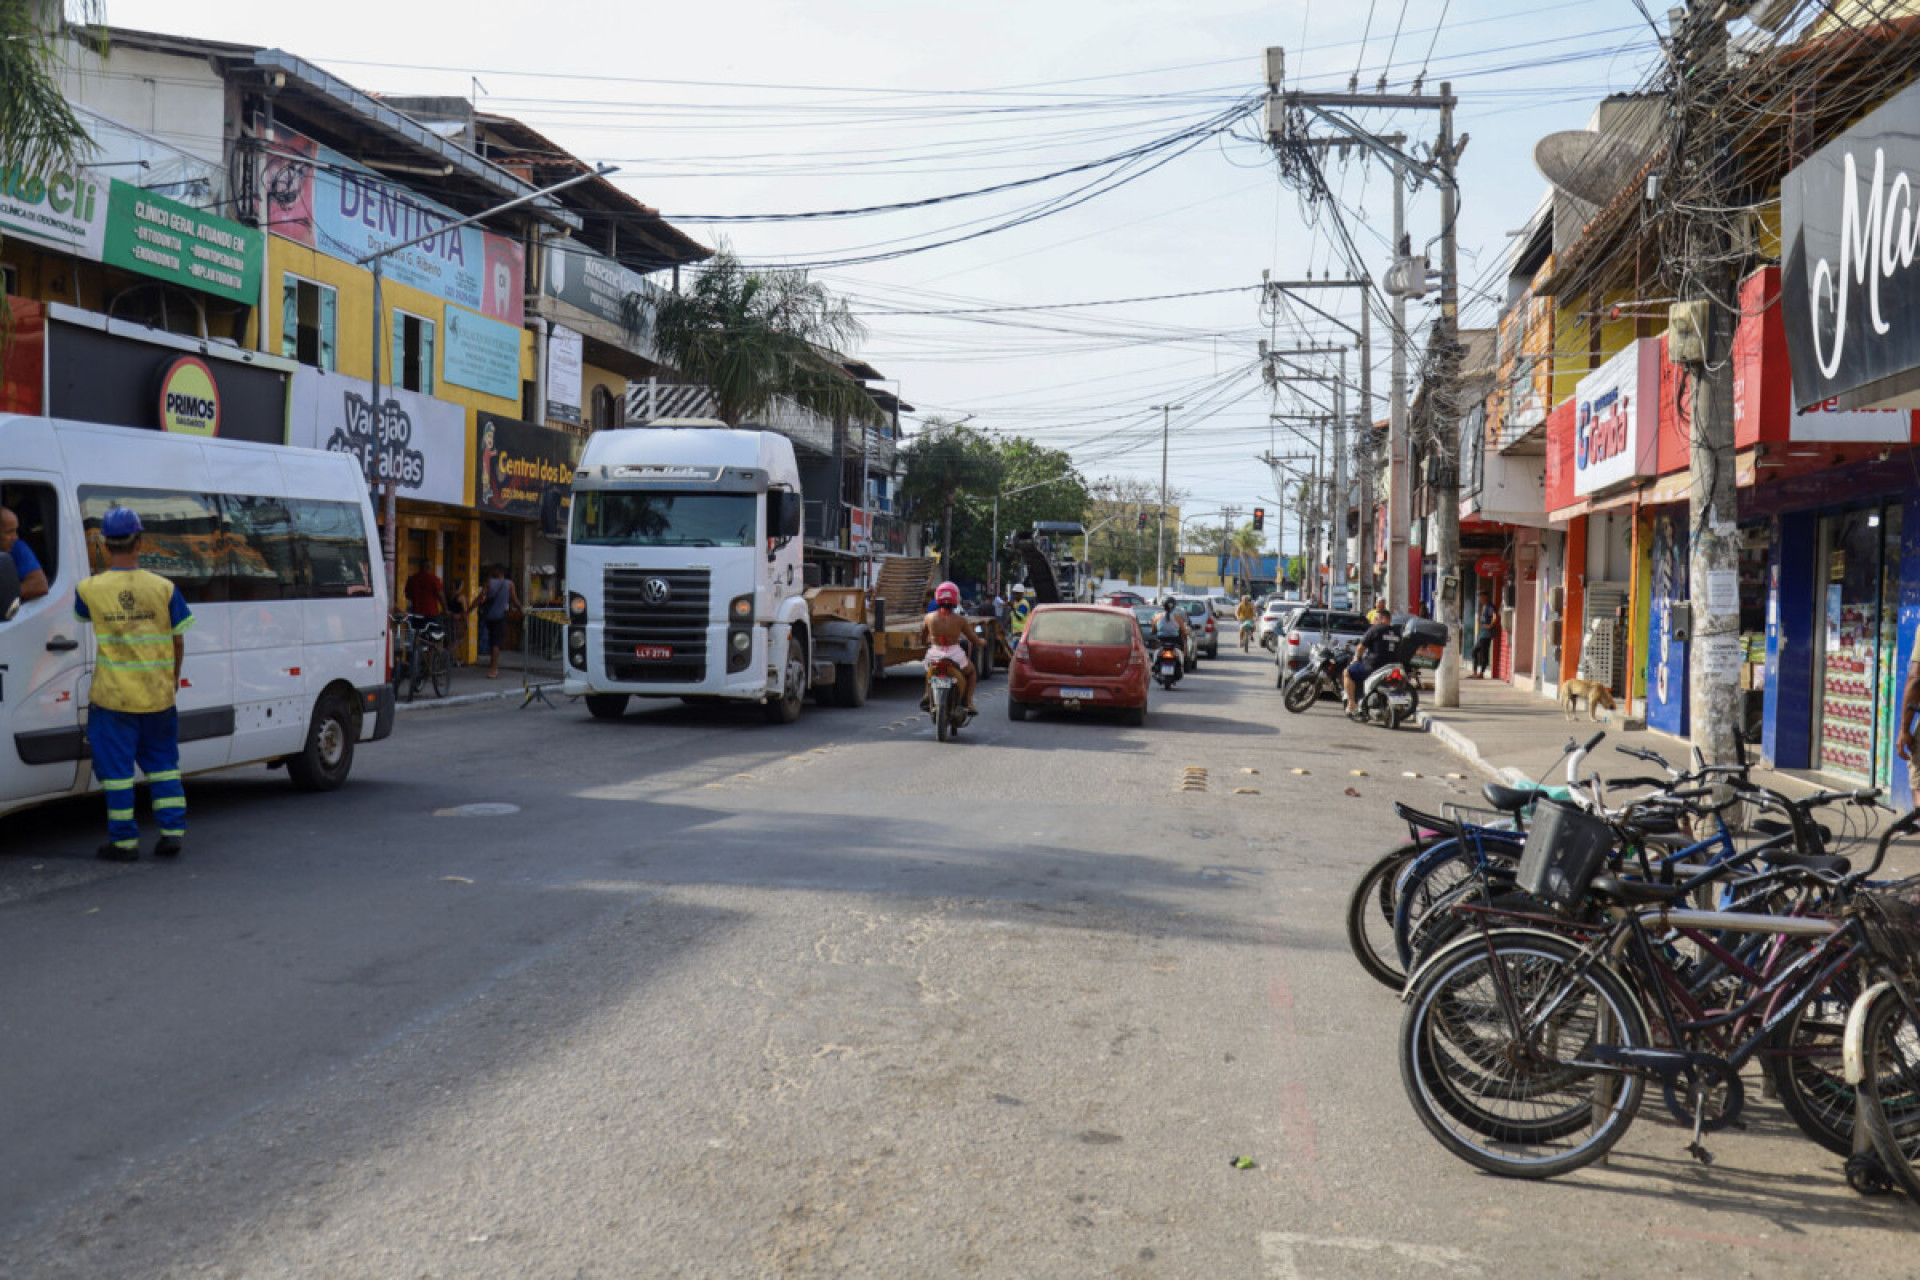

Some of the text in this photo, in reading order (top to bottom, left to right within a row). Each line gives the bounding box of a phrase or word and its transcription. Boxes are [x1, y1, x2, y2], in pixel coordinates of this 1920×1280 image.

[169, 213, 195, 236] GERAL
[197, 223, 232, 249] ATUANDO
[340, 168, 465, 268] DENTISTA
[1812, 147, 1920, 379] Ma
[167, 393, 215, 420] PRIMOS
[348, 399, 408, 446] Varejão
[363, 443, 422, 482] Faldas
[499, 451, 540, 478] Central
[541, 458, 559, 482] dos
